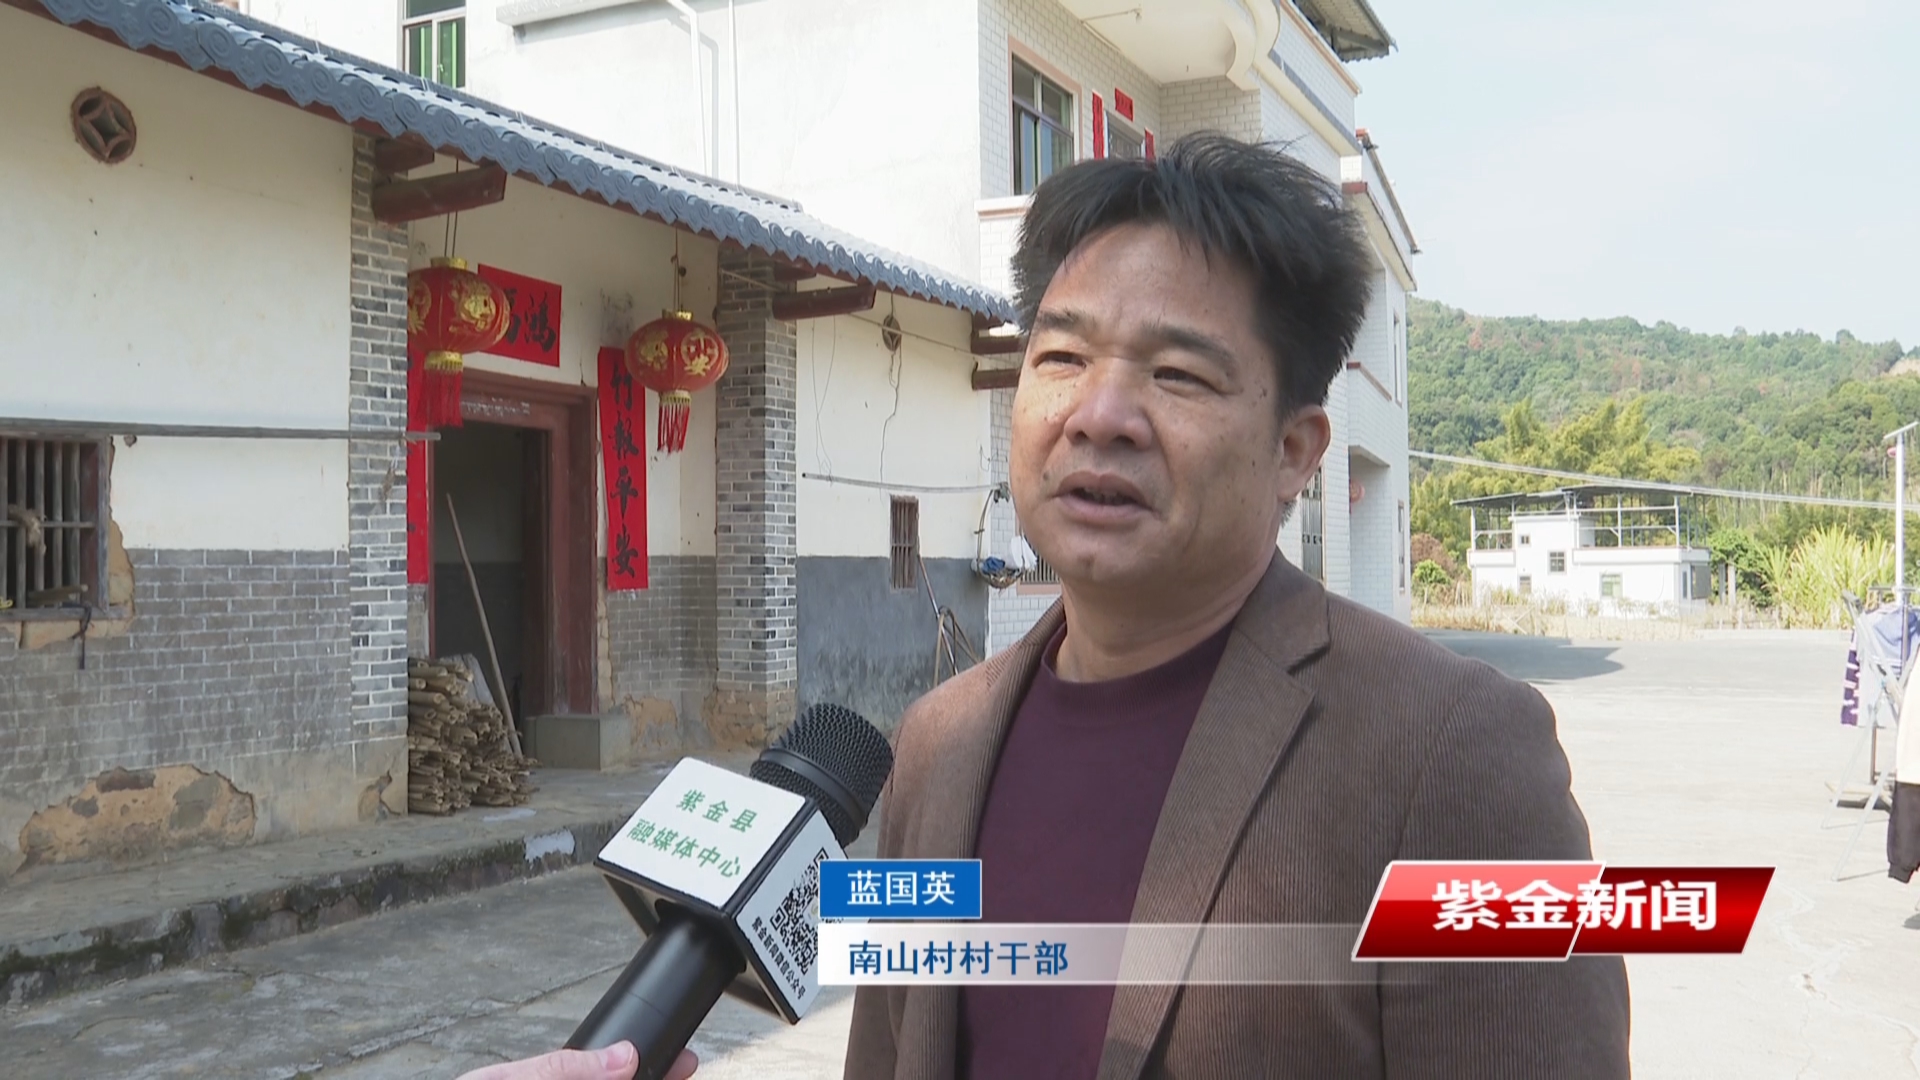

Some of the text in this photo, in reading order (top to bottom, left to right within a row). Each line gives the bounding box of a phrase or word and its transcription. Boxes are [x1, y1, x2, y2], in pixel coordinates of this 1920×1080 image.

[676, 789, 758, 833] 紫金县
[626, 818, 742, 879] 融媒体中心
[751, 916, 807, 1000] 紫金新闻微信公众号
